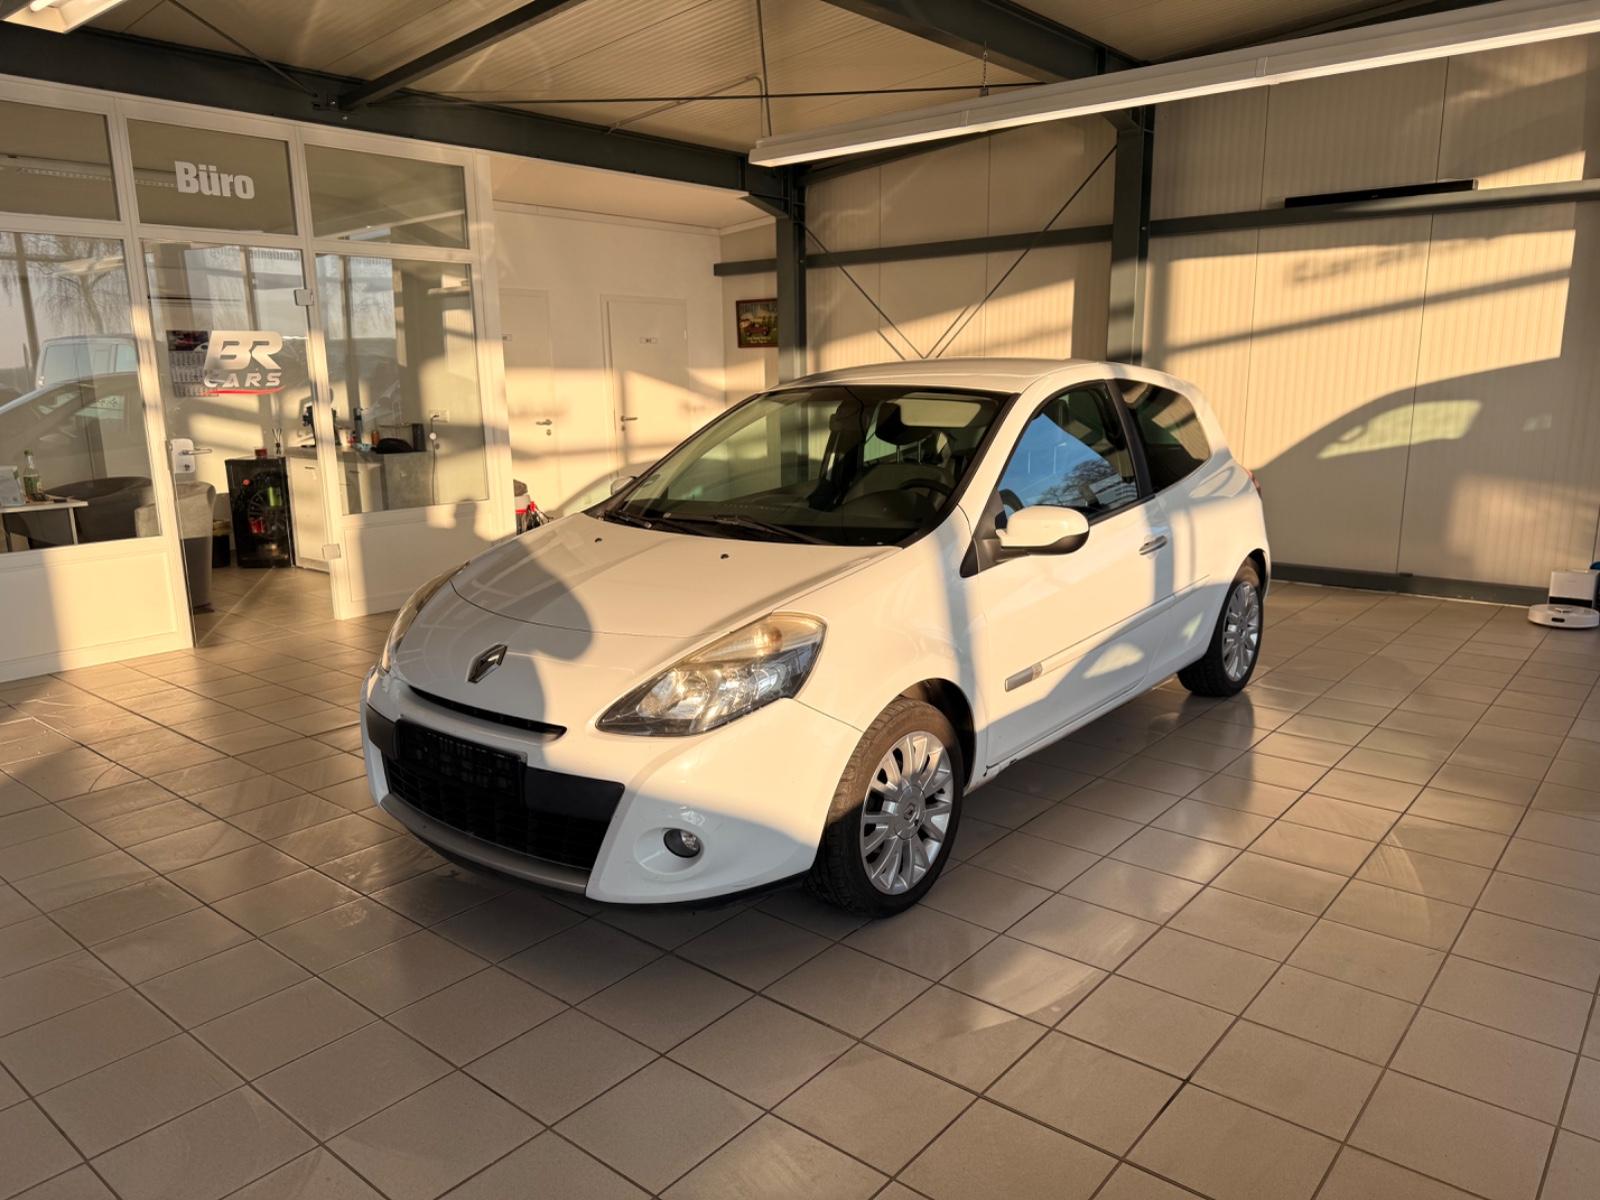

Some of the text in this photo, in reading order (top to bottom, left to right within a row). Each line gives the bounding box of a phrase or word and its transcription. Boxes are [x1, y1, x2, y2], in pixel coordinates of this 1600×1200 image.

[174, 160, 255, 199] Büro
[204, 330, 283, 370] BR
[204, 372, 282, 388] CARS
